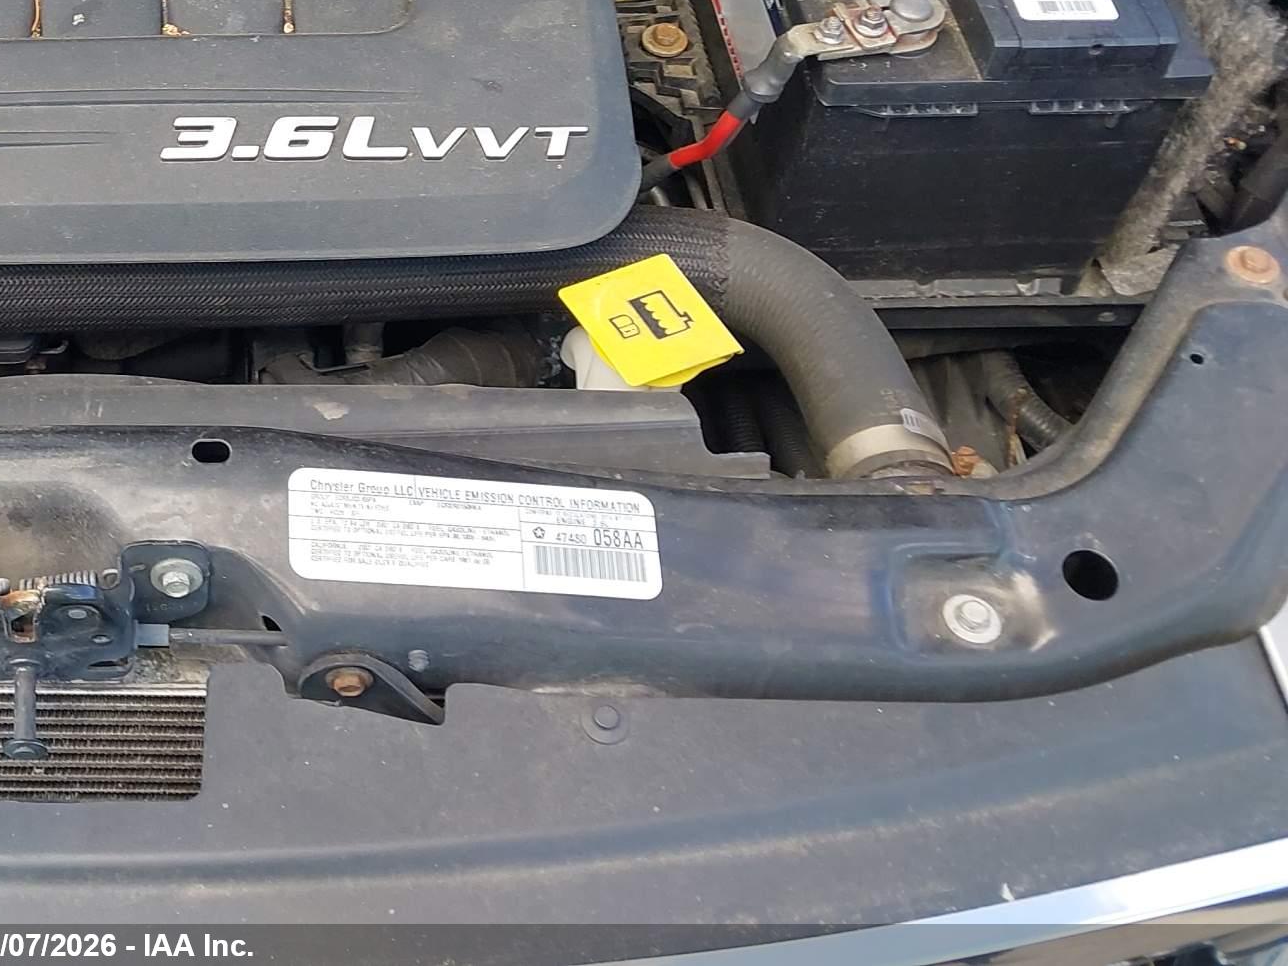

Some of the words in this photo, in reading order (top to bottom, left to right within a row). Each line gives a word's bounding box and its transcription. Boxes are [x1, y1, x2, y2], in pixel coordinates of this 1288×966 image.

[159, 114, 409, 161] 3.6L
[410, 125, 590, 161] VVT
[310, 480, 354, 494] Chrysler
[358, 482, 390, 495] Group
[394, 484, 414, 496] LLC
[418, 487, 461, 501] VEHICLE
[465, 490, 514, 505] EMISSION
[518, 494, 565, 508] CONTROL
[569, 497, 641, 514] INFORMATION
[593, 528, 644, 549] 058AA
